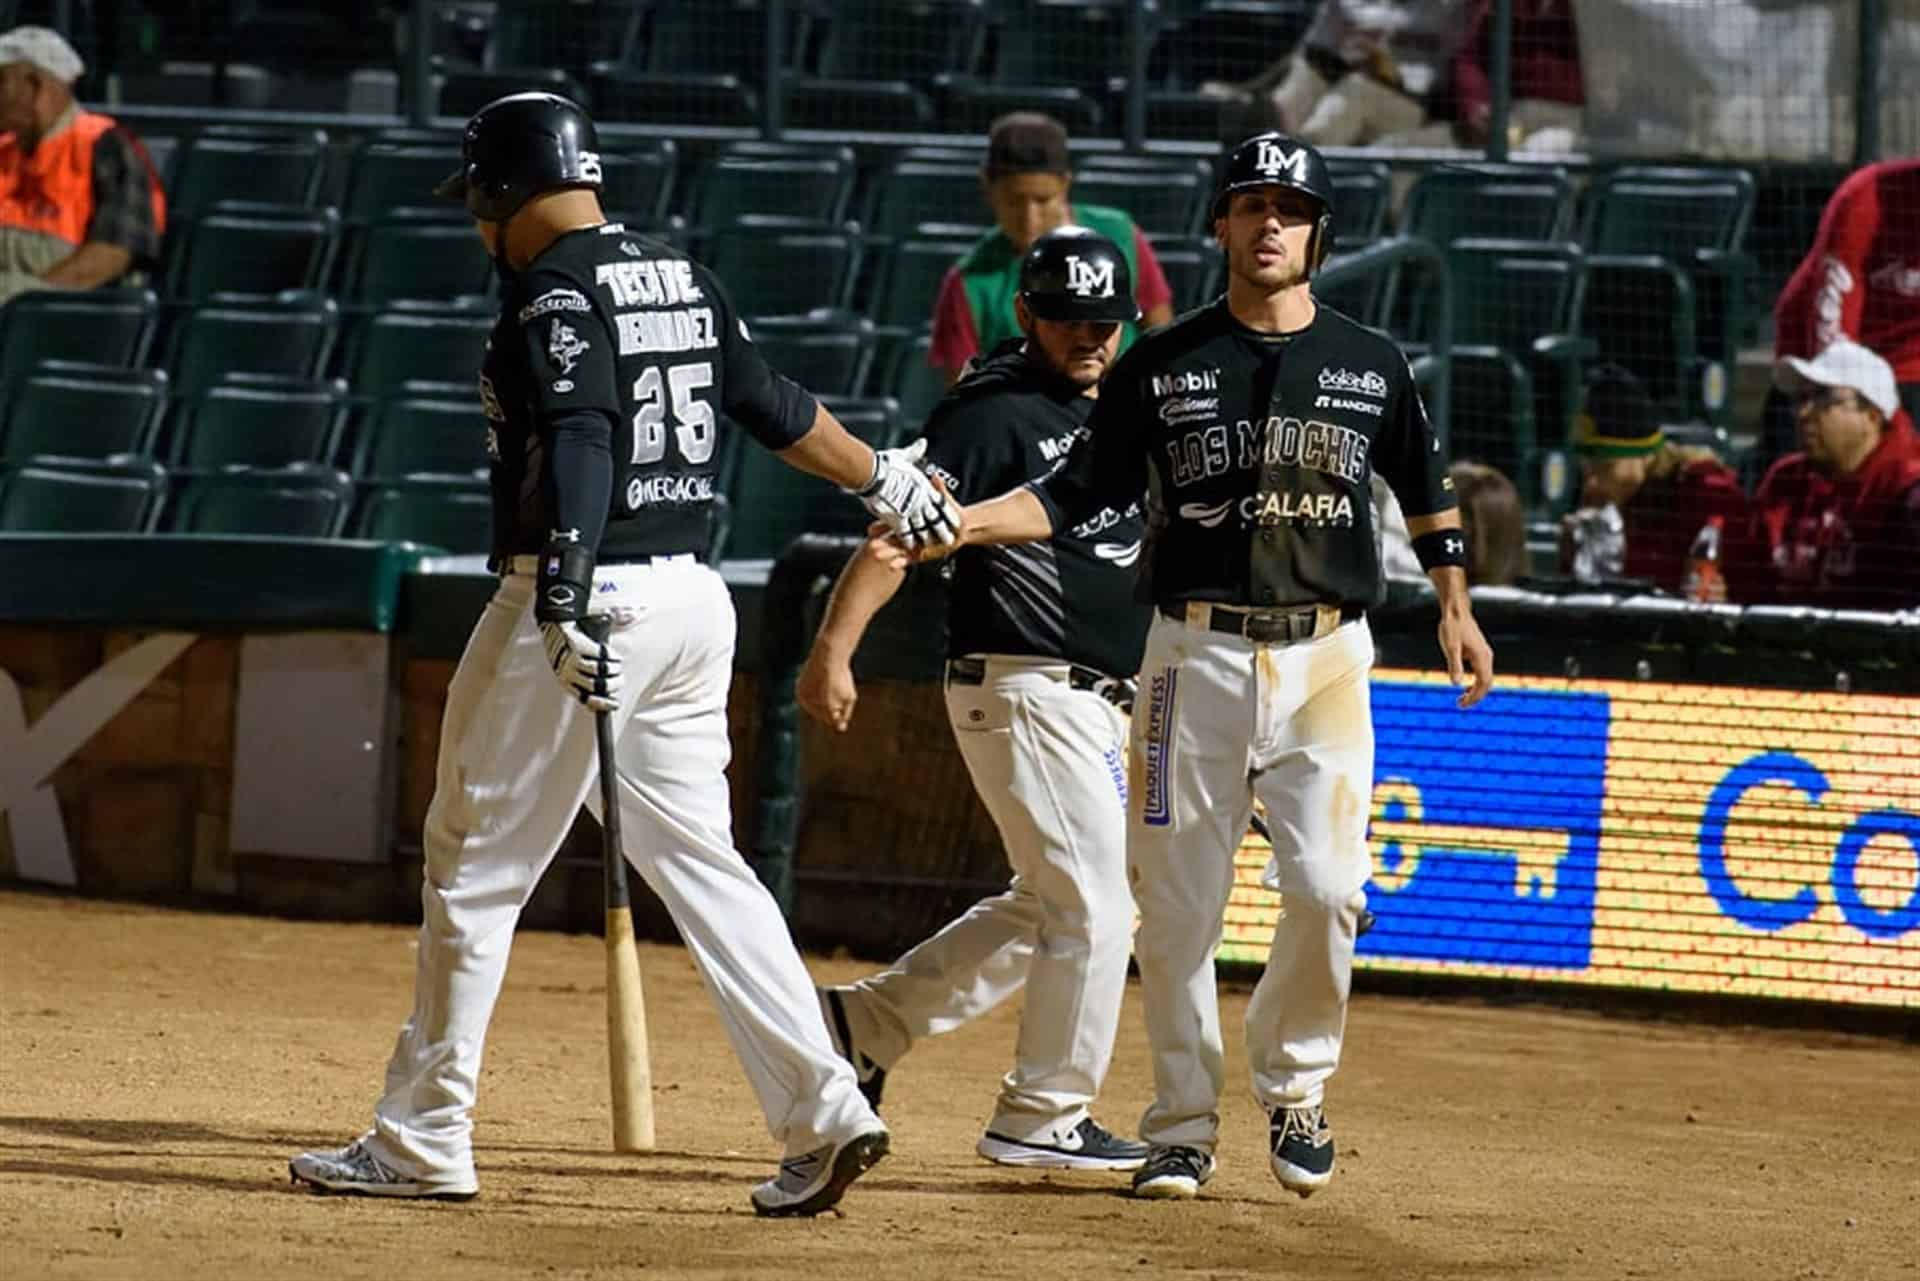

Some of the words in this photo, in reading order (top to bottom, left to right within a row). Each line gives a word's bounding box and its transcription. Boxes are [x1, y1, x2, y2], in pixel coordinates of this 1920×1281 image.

[632, 363, 716, 465] 25
[1166, 425, 1230, 487] LOS
[1699, 749, 1920, 938] Co
